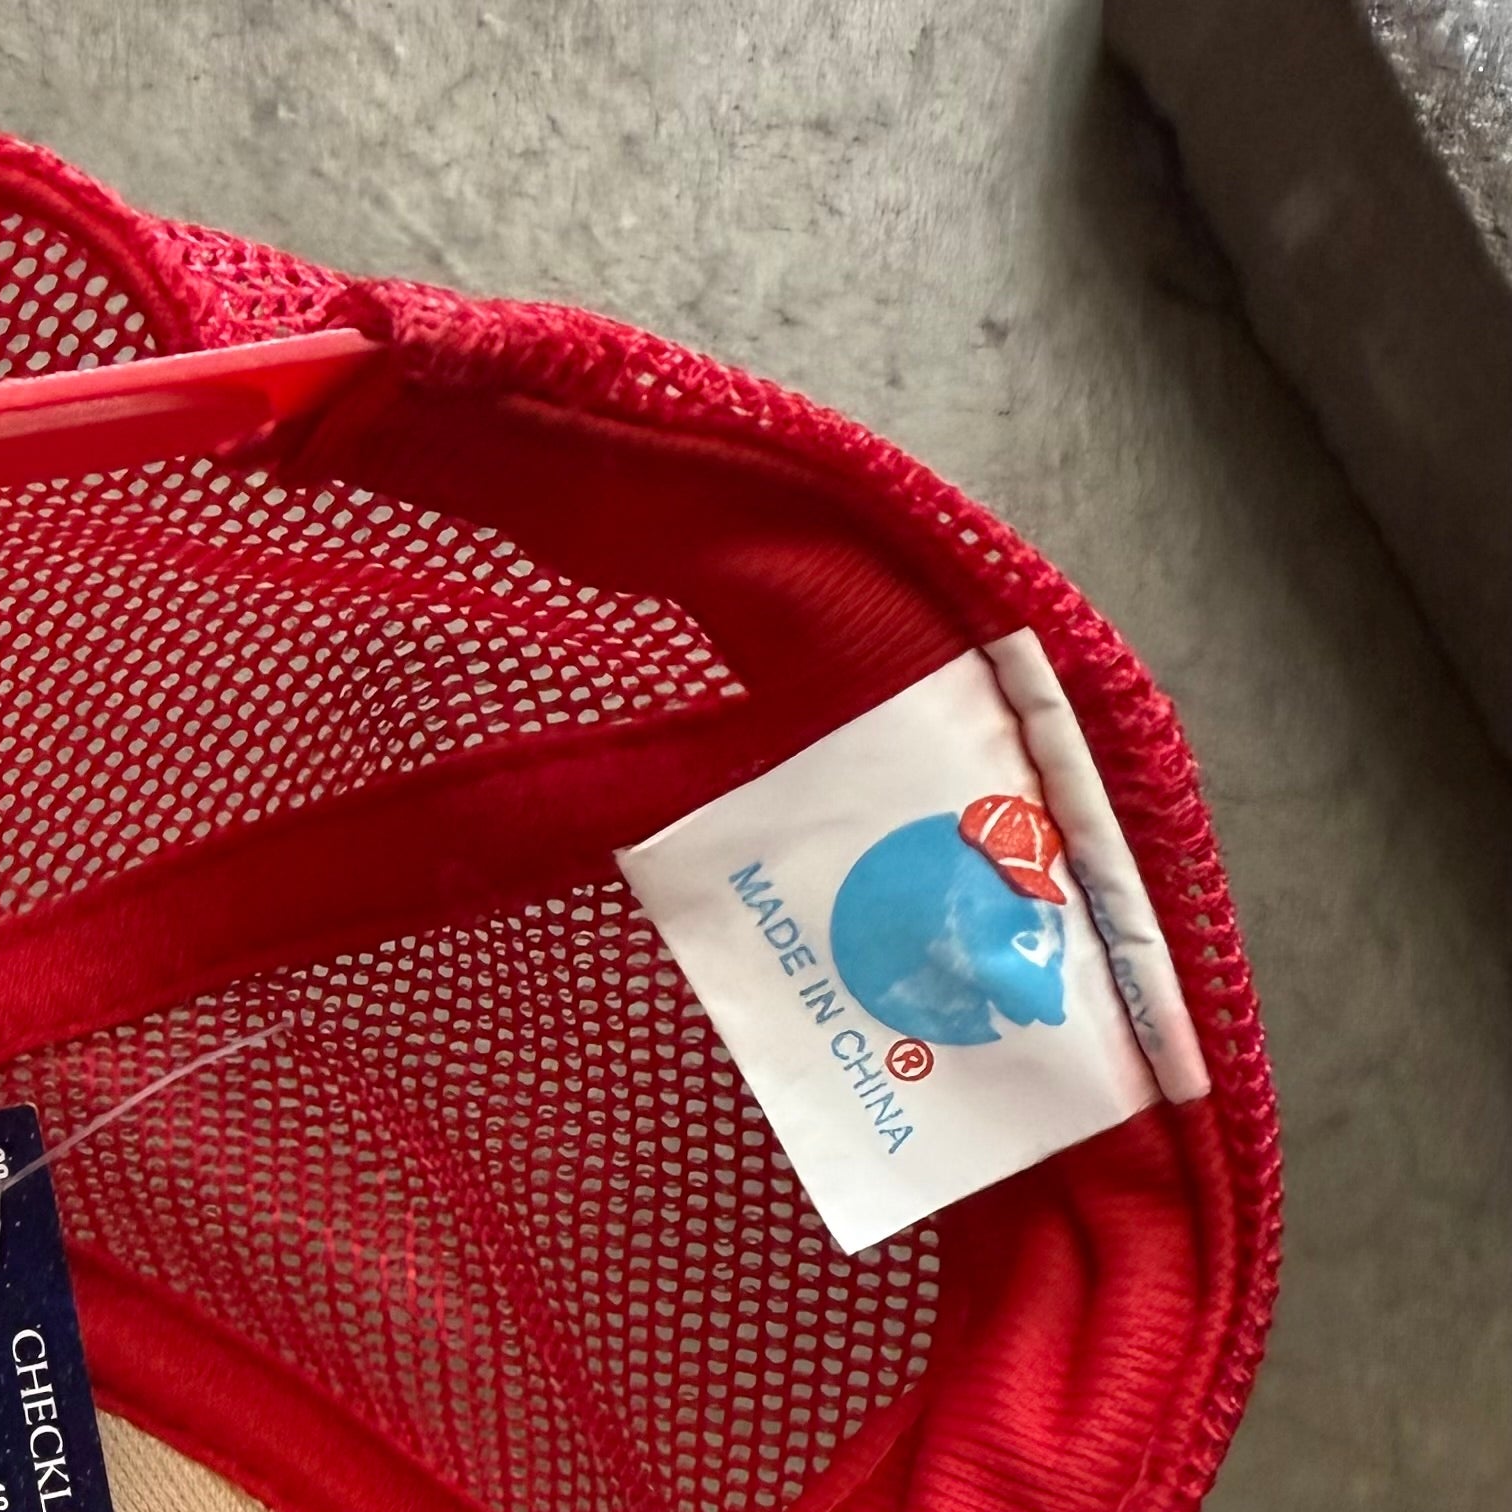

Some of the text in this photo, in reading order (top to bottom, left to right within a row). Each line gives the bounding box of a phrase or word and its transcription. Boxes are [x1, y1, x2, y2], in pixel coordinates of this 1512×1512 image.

[729, 862, 914, 1154] MADE IN CHINA
